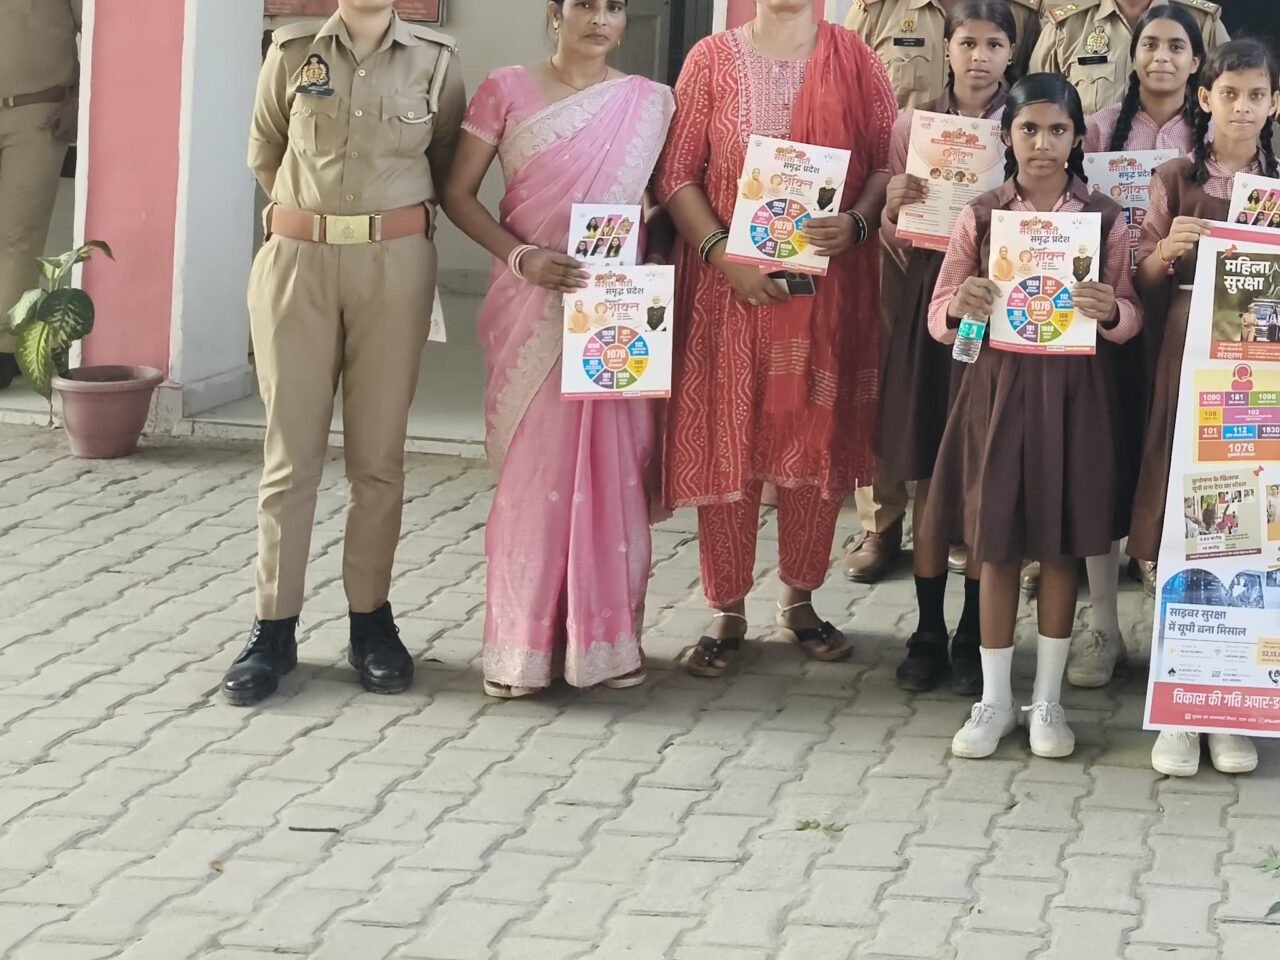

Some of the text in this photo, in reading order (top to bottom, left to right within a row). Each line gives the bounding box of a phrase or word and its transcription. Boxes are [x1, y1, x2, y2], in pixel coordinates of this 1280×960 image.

[1225, 257, 1271, 275] महिला
[1223, 275, 1264, 294] सुरक्षा
[1030, 301, 1050, 310] 1076
[1227, 443, 1255, 452] 1076
[1201, 609, 1226, 623] सुरक्षा
[1168, 621, 1176, 632] में
[1177, 622, 1195, 637] यूपी
[1216, 625, 1246, 637] मिसाल
[1173, 688, 1206, 705] विकास
[1208, 690, 1221, 707] की
[1224, 691, 1242, 707] गति
